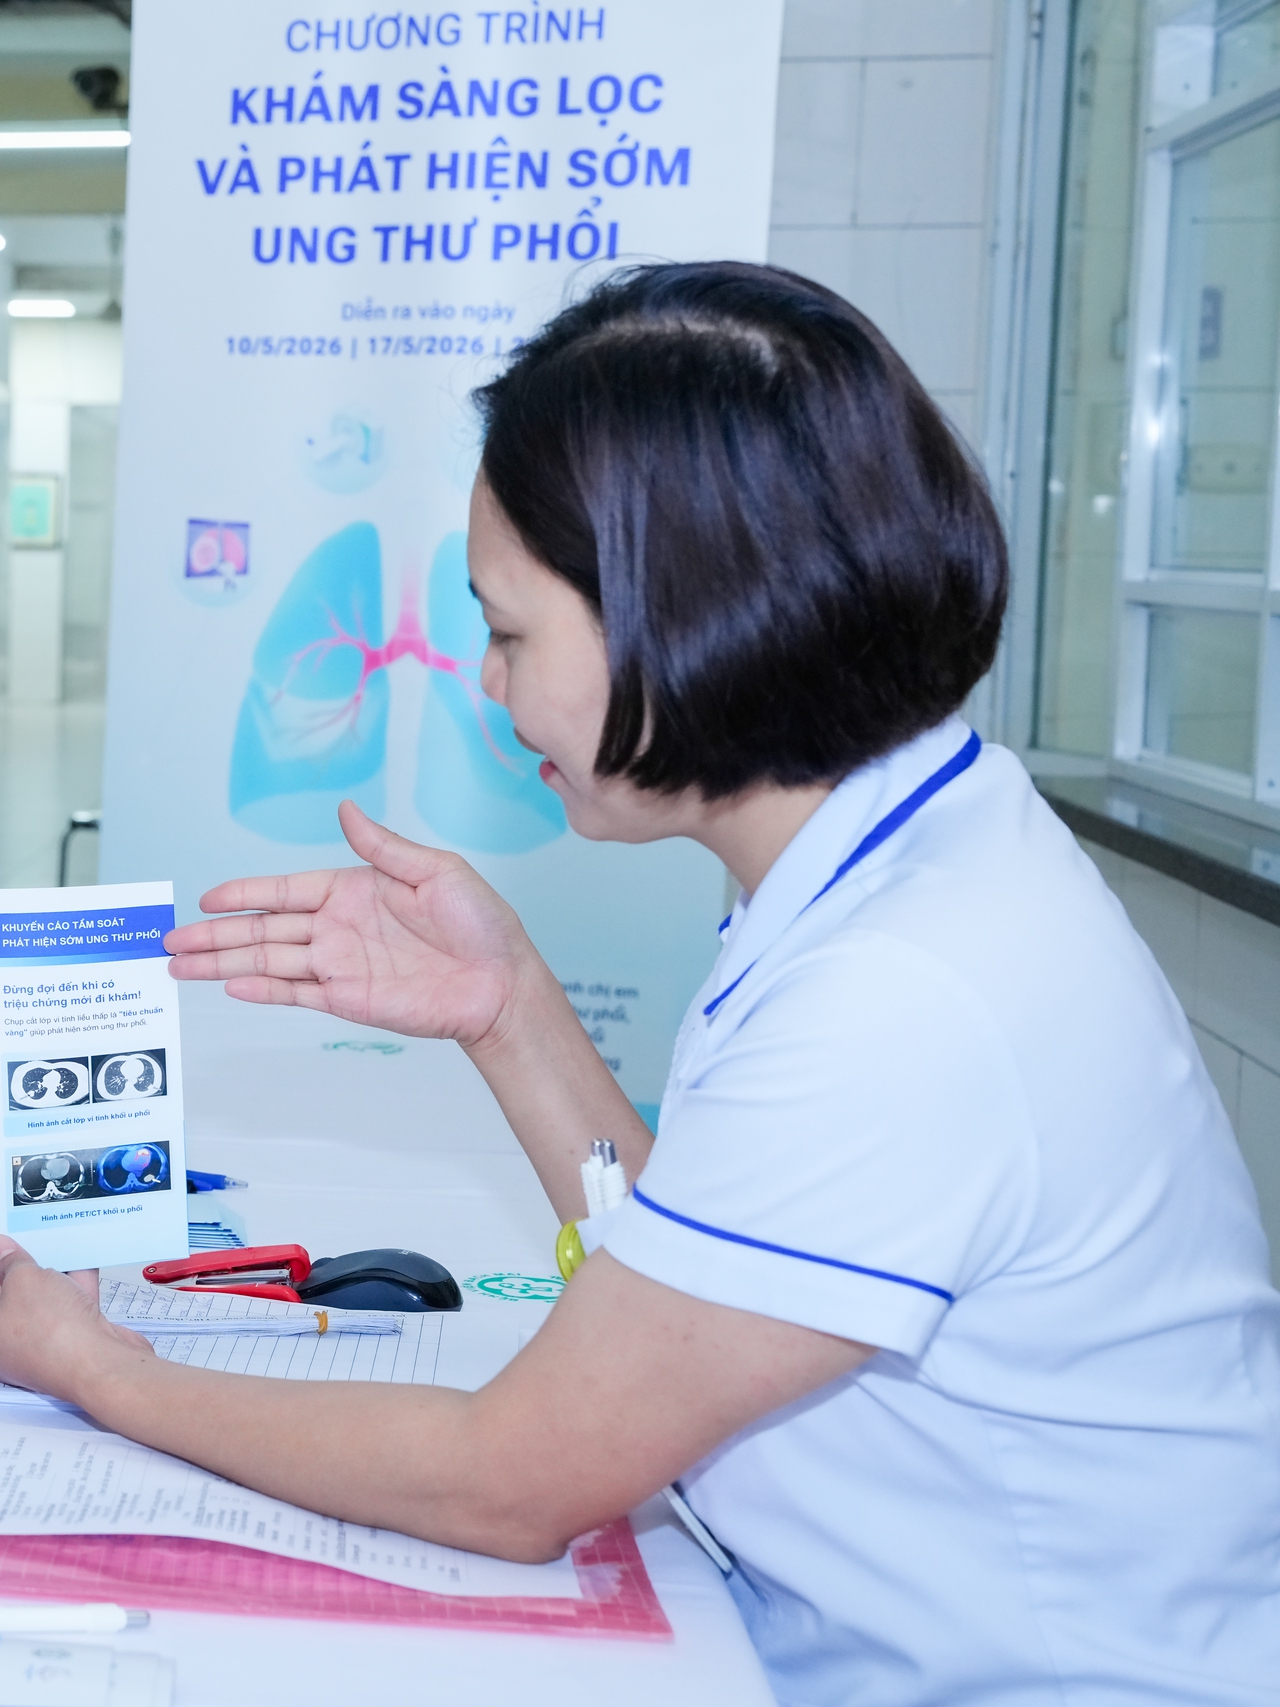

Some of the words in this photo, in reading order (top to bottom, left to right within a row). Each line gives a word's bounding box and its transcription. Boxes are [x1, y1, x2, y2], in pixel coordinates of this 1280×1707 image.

[286, 10, 462, 53] CHƯƠNG
[479, 0, 604, 45] TRÌNH
[230, 71, 380, 125] KHÁM
[396, 65, 540, 119] SÀNG
[557, 74, 663, 126] LỌC
[196, 144, 261, 195] VÀ
[277, 141, 412, 194] PHÁT
[426, 135, 549, 201] HIỆN
[567, 134, 692, 188] SỚM
[252, 226, 357, 264] UNG
[373, 217, 479, 263] THƯ
[491, 197, 620, 261] PHỔI
[341, 297, 386, 321] Diễn
[392, 306, 411, 320] ra
[419, 300, 456, 320] vào
[462, 302, 516, 323] ngày
[227, 336, 342, 358] 10/5/2026
[368, 336, 484, 357] 17/5/2026
[2, 921, 44, 932] KHUYẾN
[47, 920, 70, 930] CÁO
[97, 917, 125, 928] SOÁT
[2, 937, 30, 947] PHÁT
[33, 936, 57, 948] HIỆN
[60, 934, 83, 946] SỚM
[86, 934, 108, 944] UNG
[111, 932, 134, 941] THƯ
[136, 930, 161, 939] PHỔI
[3, 984, 33, 996] Đừng
[37, 983, 55, 994] đợi
[59, 981, 79, 992] đến
[82, 981, 98, 990] khi
[101, 979, 114, 989] có
[4, 998, 28, 1010] triệu
[32, 997, 68, 1009] chứng
[71, 996, 92, 1006] mới
[95, 994, 105, 1003] đi
[108, 991, 141, 1002] khám!
[4, 1017, 24, 1026] Chụp
[26, 1016, 38, 1025] cắt
[39, 1016, 51, 1025] lớp
[61, 1014, 76, 1023] tính
[92, 1011, 109, 1021] thấp
[110, 1011, 117, 1019] là
[140, 1007, 163, 1015] chuẩn
[30, 1028, 46, 1037] giúp
[47, 1027, 63, 1035] phát
[65, 1025, 81, 1034] hiện
[83, 1024, 99, 1032] sớm
[74, 1116, 86, 1125] lớp
[111, 1111, 126, 1120] khối
[41, 1214, 58, 1222] Hình
[75, 1210, 101, 1218] PET/CT
[103, 1207, 119, 1215] khối
